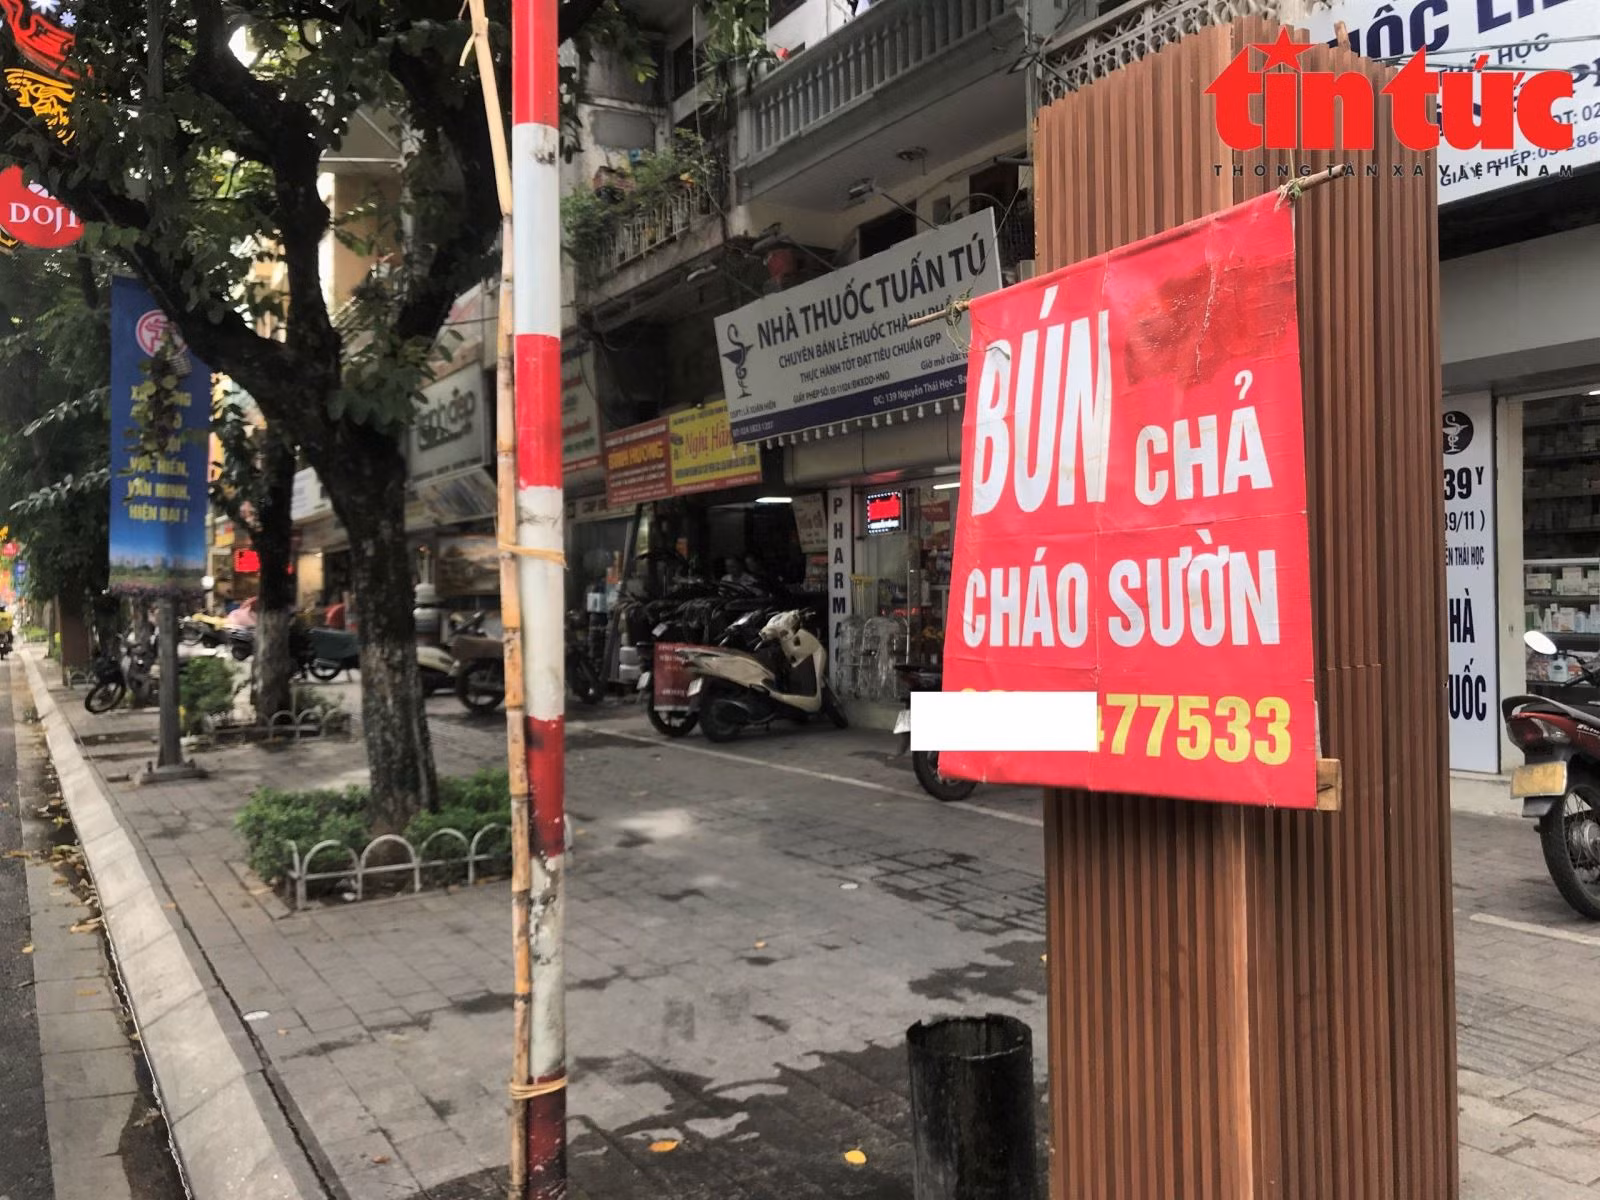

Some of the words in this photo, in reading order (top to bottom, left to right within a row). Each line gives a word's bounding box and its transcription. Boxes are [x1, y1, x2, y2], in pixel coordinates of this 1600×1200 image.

[9, 202, 80, 235] DOJI
[757, 306, 798, 349] NHÀ
[800, 277, 873, 333] THUỐC
[875, 252, 945, 308] TUẤN
[948, 233, 986, 282] TÚ
[923, 332, 942, 350] GPP
[972, 285, 1112, 517] BÚN
[1134, 370, 1273, 505] CHẢ
[963, 547, 1088, 648] CHÁO
[1108, 529, 1280, 647] SƯỜN
[1455, 543, 1469, 566] THÁI
[1471, 546, 1485, 570] HỌC
[1449, 588, 1474, 644] HÀ
[1449, 658, 1486, 722] UỐC
[1097, 693, 1291, 765] 77533
